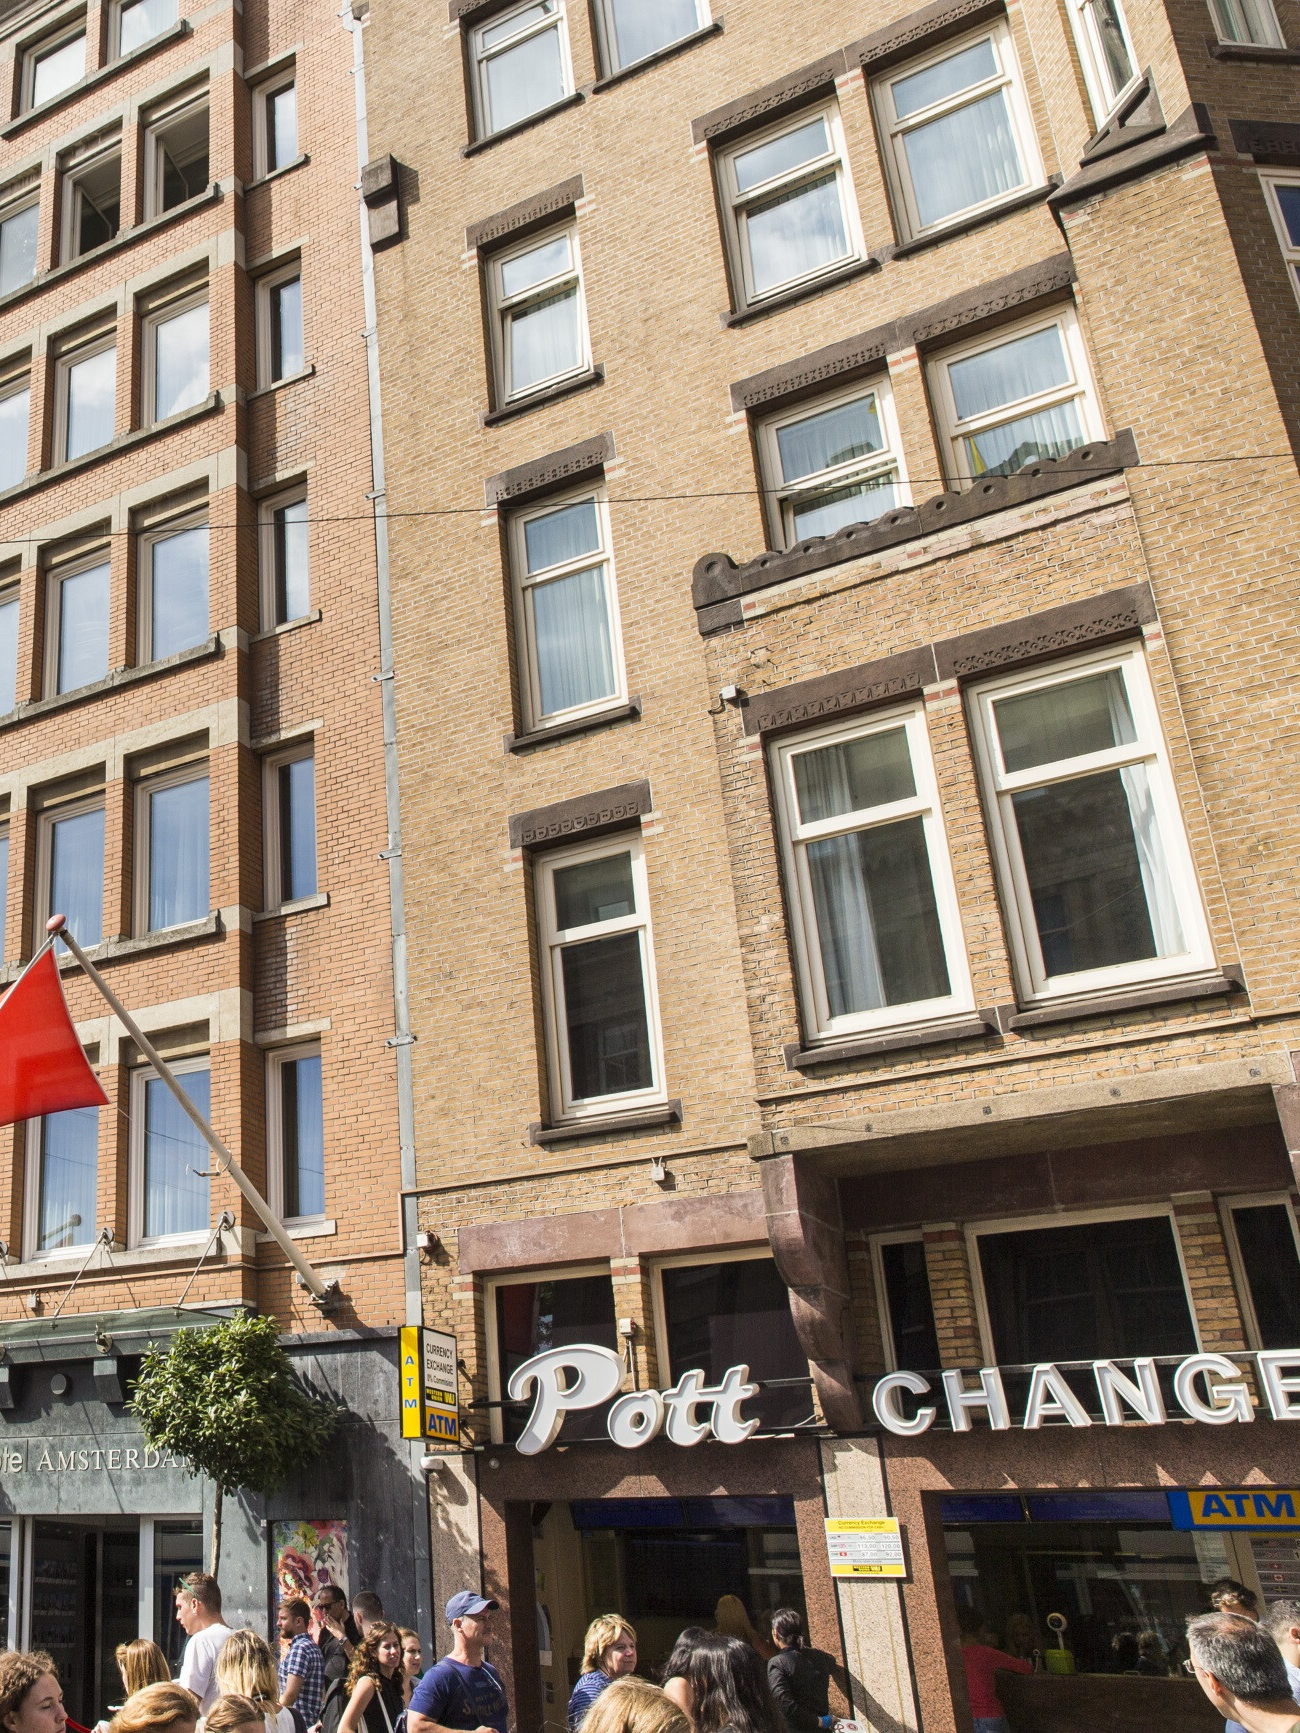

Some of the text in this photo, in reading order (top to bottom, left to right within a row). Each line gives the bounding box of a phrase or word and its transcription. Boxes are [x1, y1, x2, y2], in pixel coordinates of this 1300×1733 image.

[426, 1343, 453, 1360] CURRENCY
[426, 1358, 454, 1376] EXCHANGE
[426, 1388, 443, 1397] WESTERN
[431, 1394, 443, 1402] UNION
[508, 1343, 760, 1455] Pott
[872, 1349, 1300, 1436] CHANGE
[428, 1413, 457, 1437] ATM
[1202, 1494, 1296, 1517] ATM
